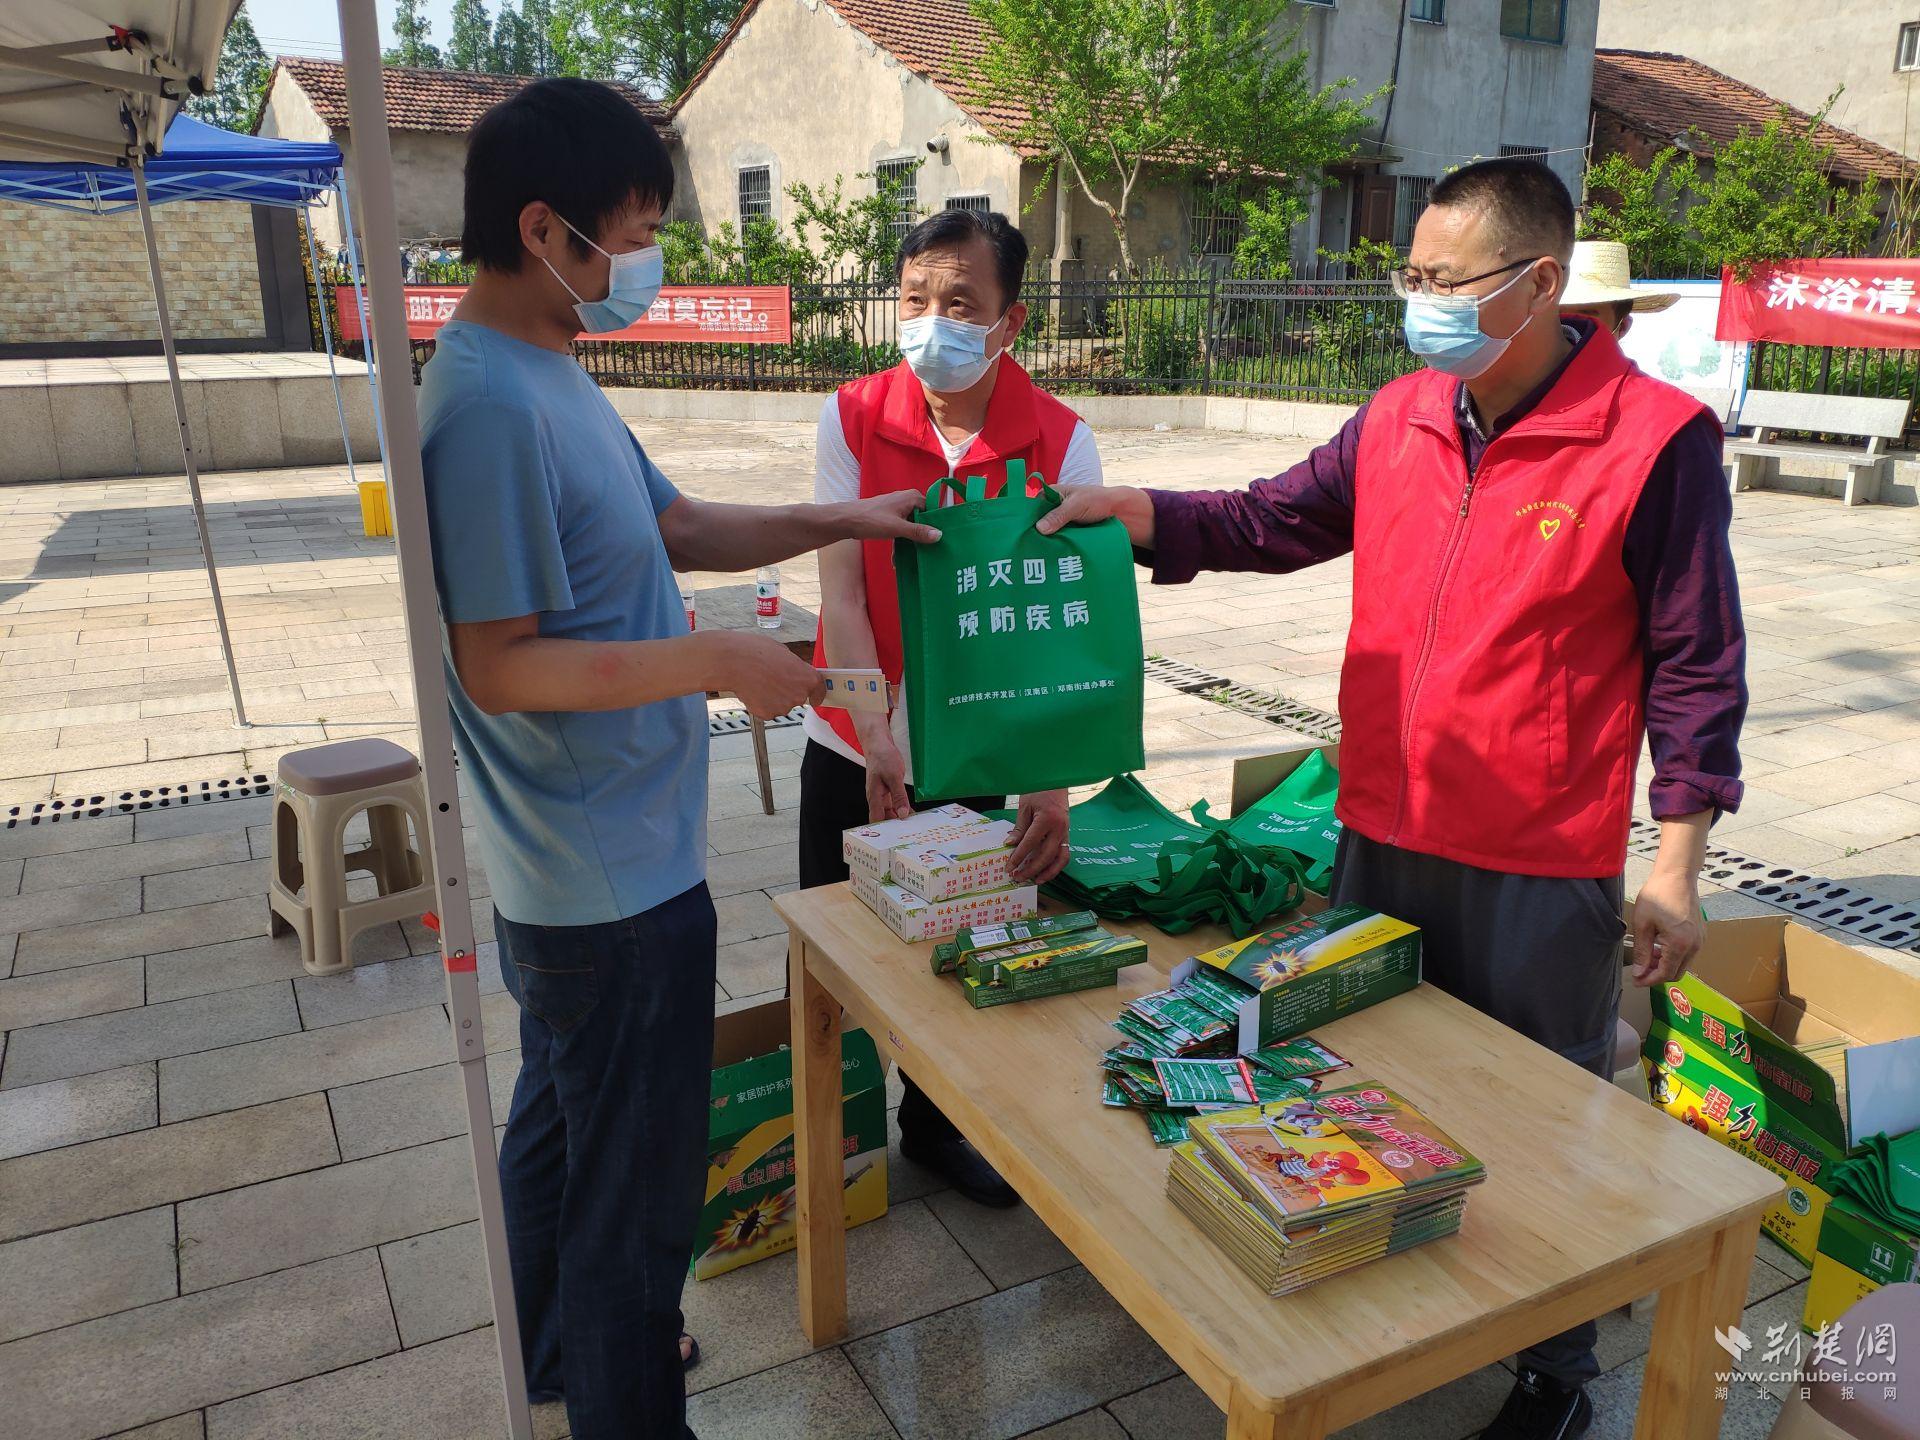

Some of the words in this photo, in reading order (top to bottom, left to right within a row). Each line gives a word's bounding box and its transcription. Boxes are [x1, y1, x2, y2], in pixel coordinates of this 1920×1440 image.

[1766, 276, 1915, 315] 沐浴清
[956, 555, 1085, 596] 消灭四害
[958, 600, 1090, 640] 预防疾病
[1701, 1084, 1821, 1183] 强力粘鼠板
